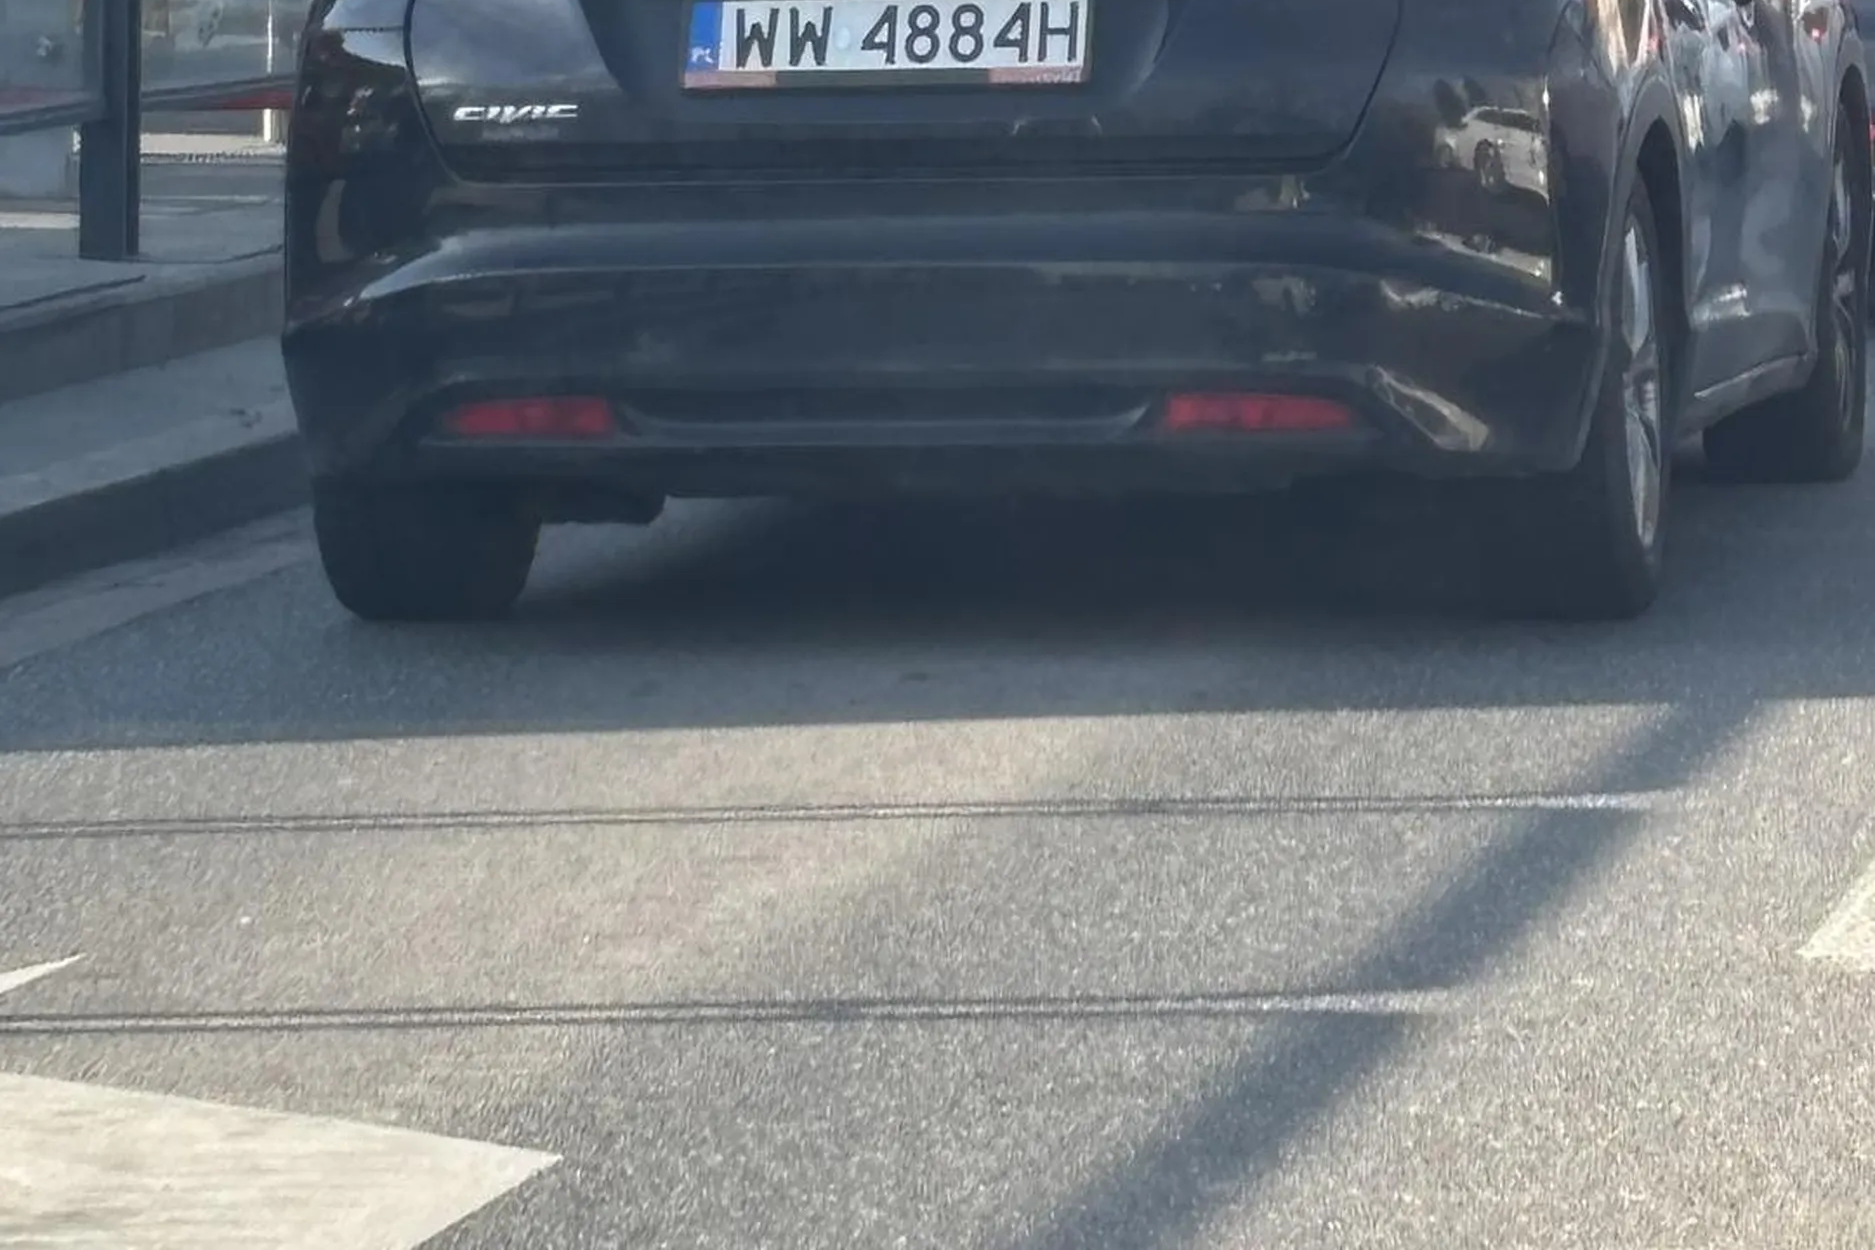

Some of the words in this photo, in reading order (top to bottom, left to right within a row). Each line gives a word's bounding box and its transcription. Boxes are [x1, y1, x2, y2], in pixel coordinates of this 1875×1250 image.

[736, 7, 833, 68] WW
[860, 1, 1079, 64] 4884H
[453, 104, 579, 124] CIVIC
